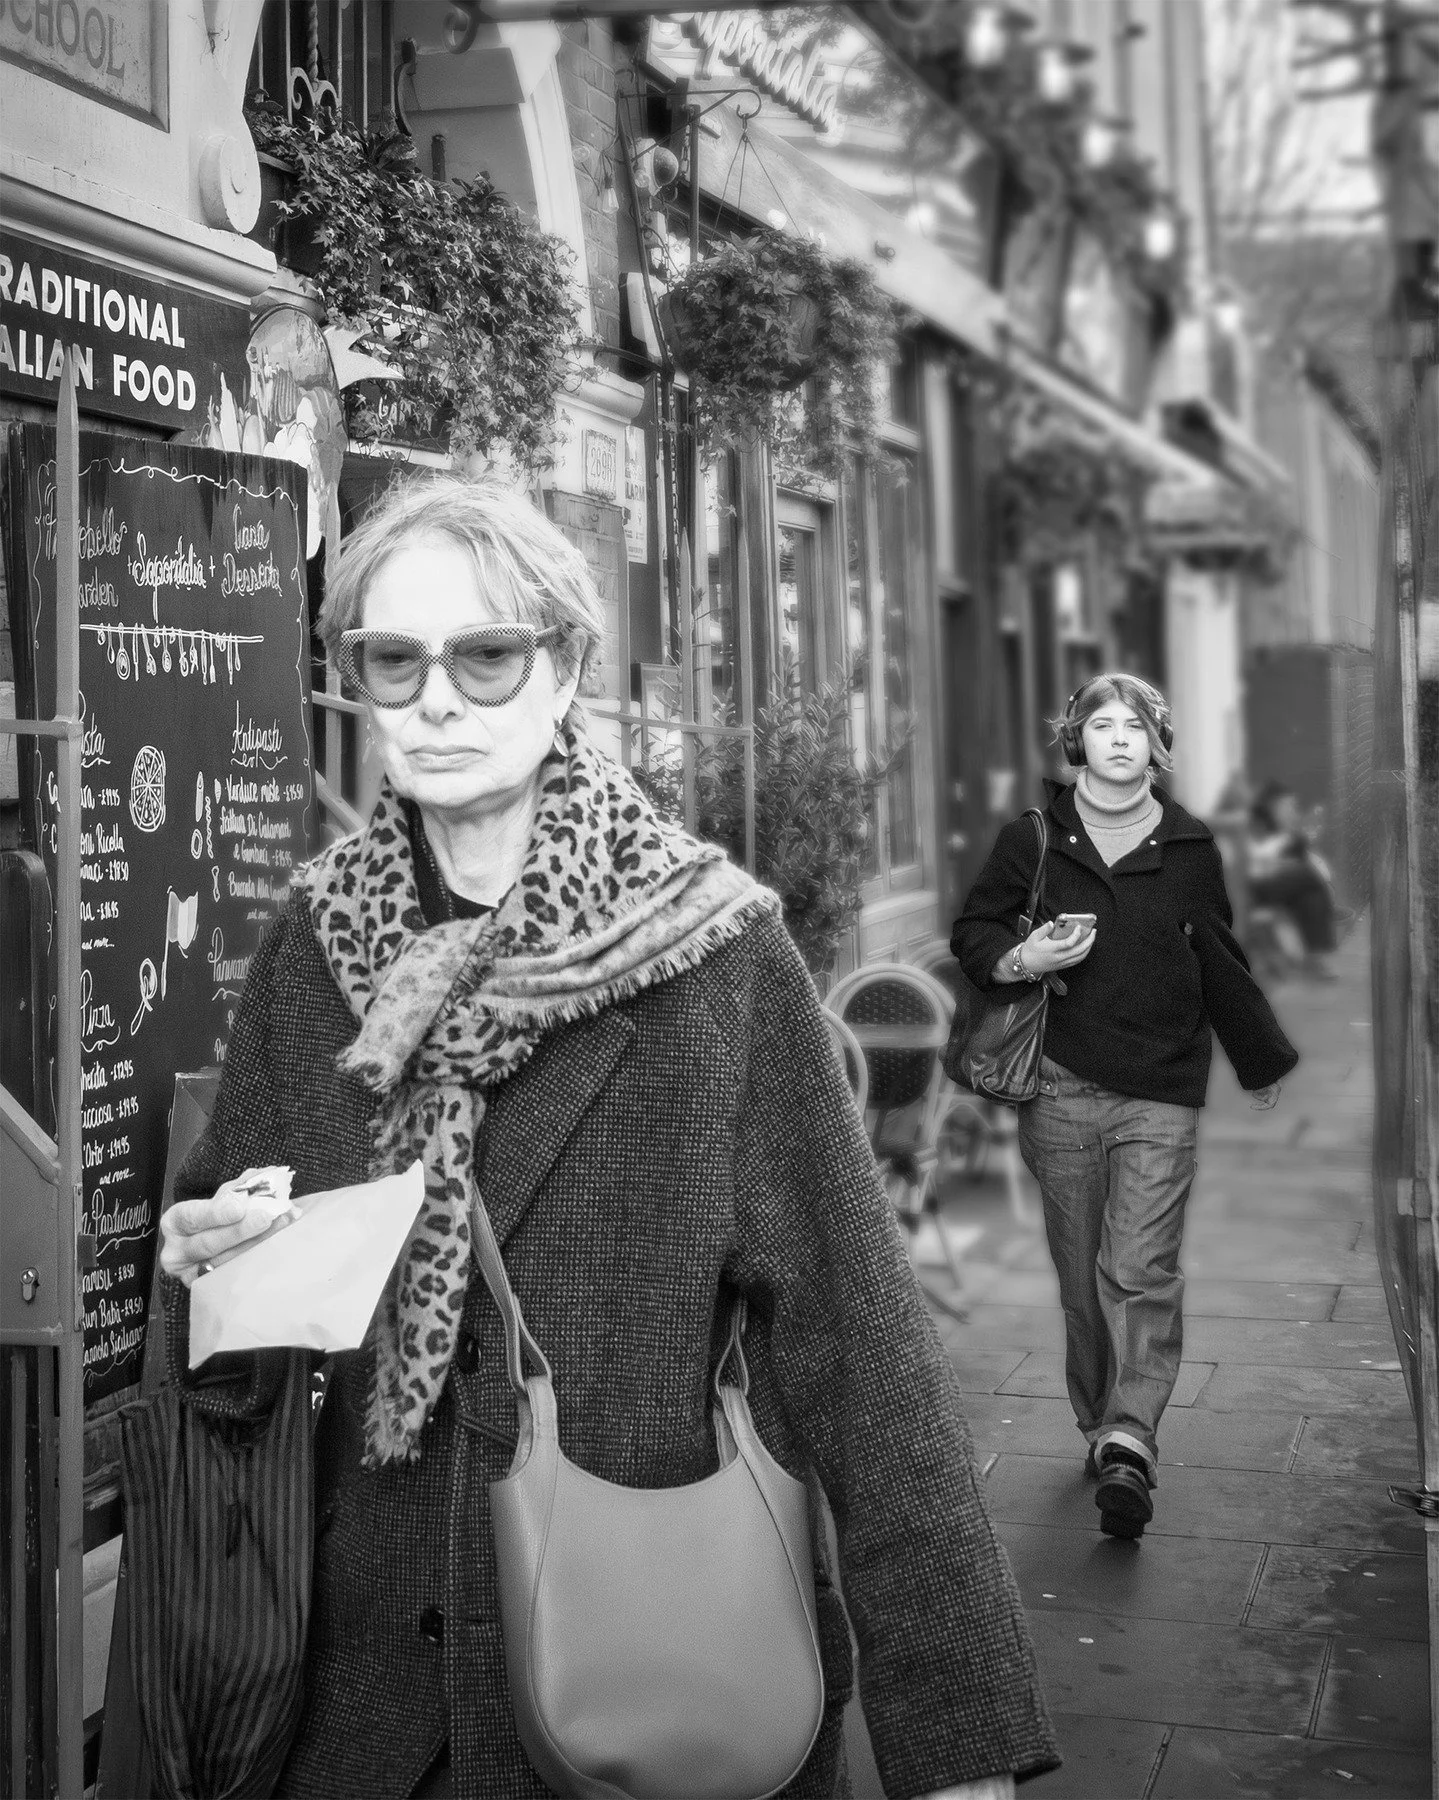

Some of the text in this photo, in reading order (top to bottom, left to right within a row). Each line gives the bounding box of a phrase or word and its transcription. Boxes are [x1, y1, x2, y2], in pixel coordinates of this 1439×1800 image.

[0, 0, 125, 79] CHOOL
[113, 353, 197, 411] FOOD
[79, 566, 119, 611] arden
[80, 968, 116, 1038] Pizza
[81, 1100, 115, 1130] icciosa
[82, 1262, 114, 1293] ramisu
